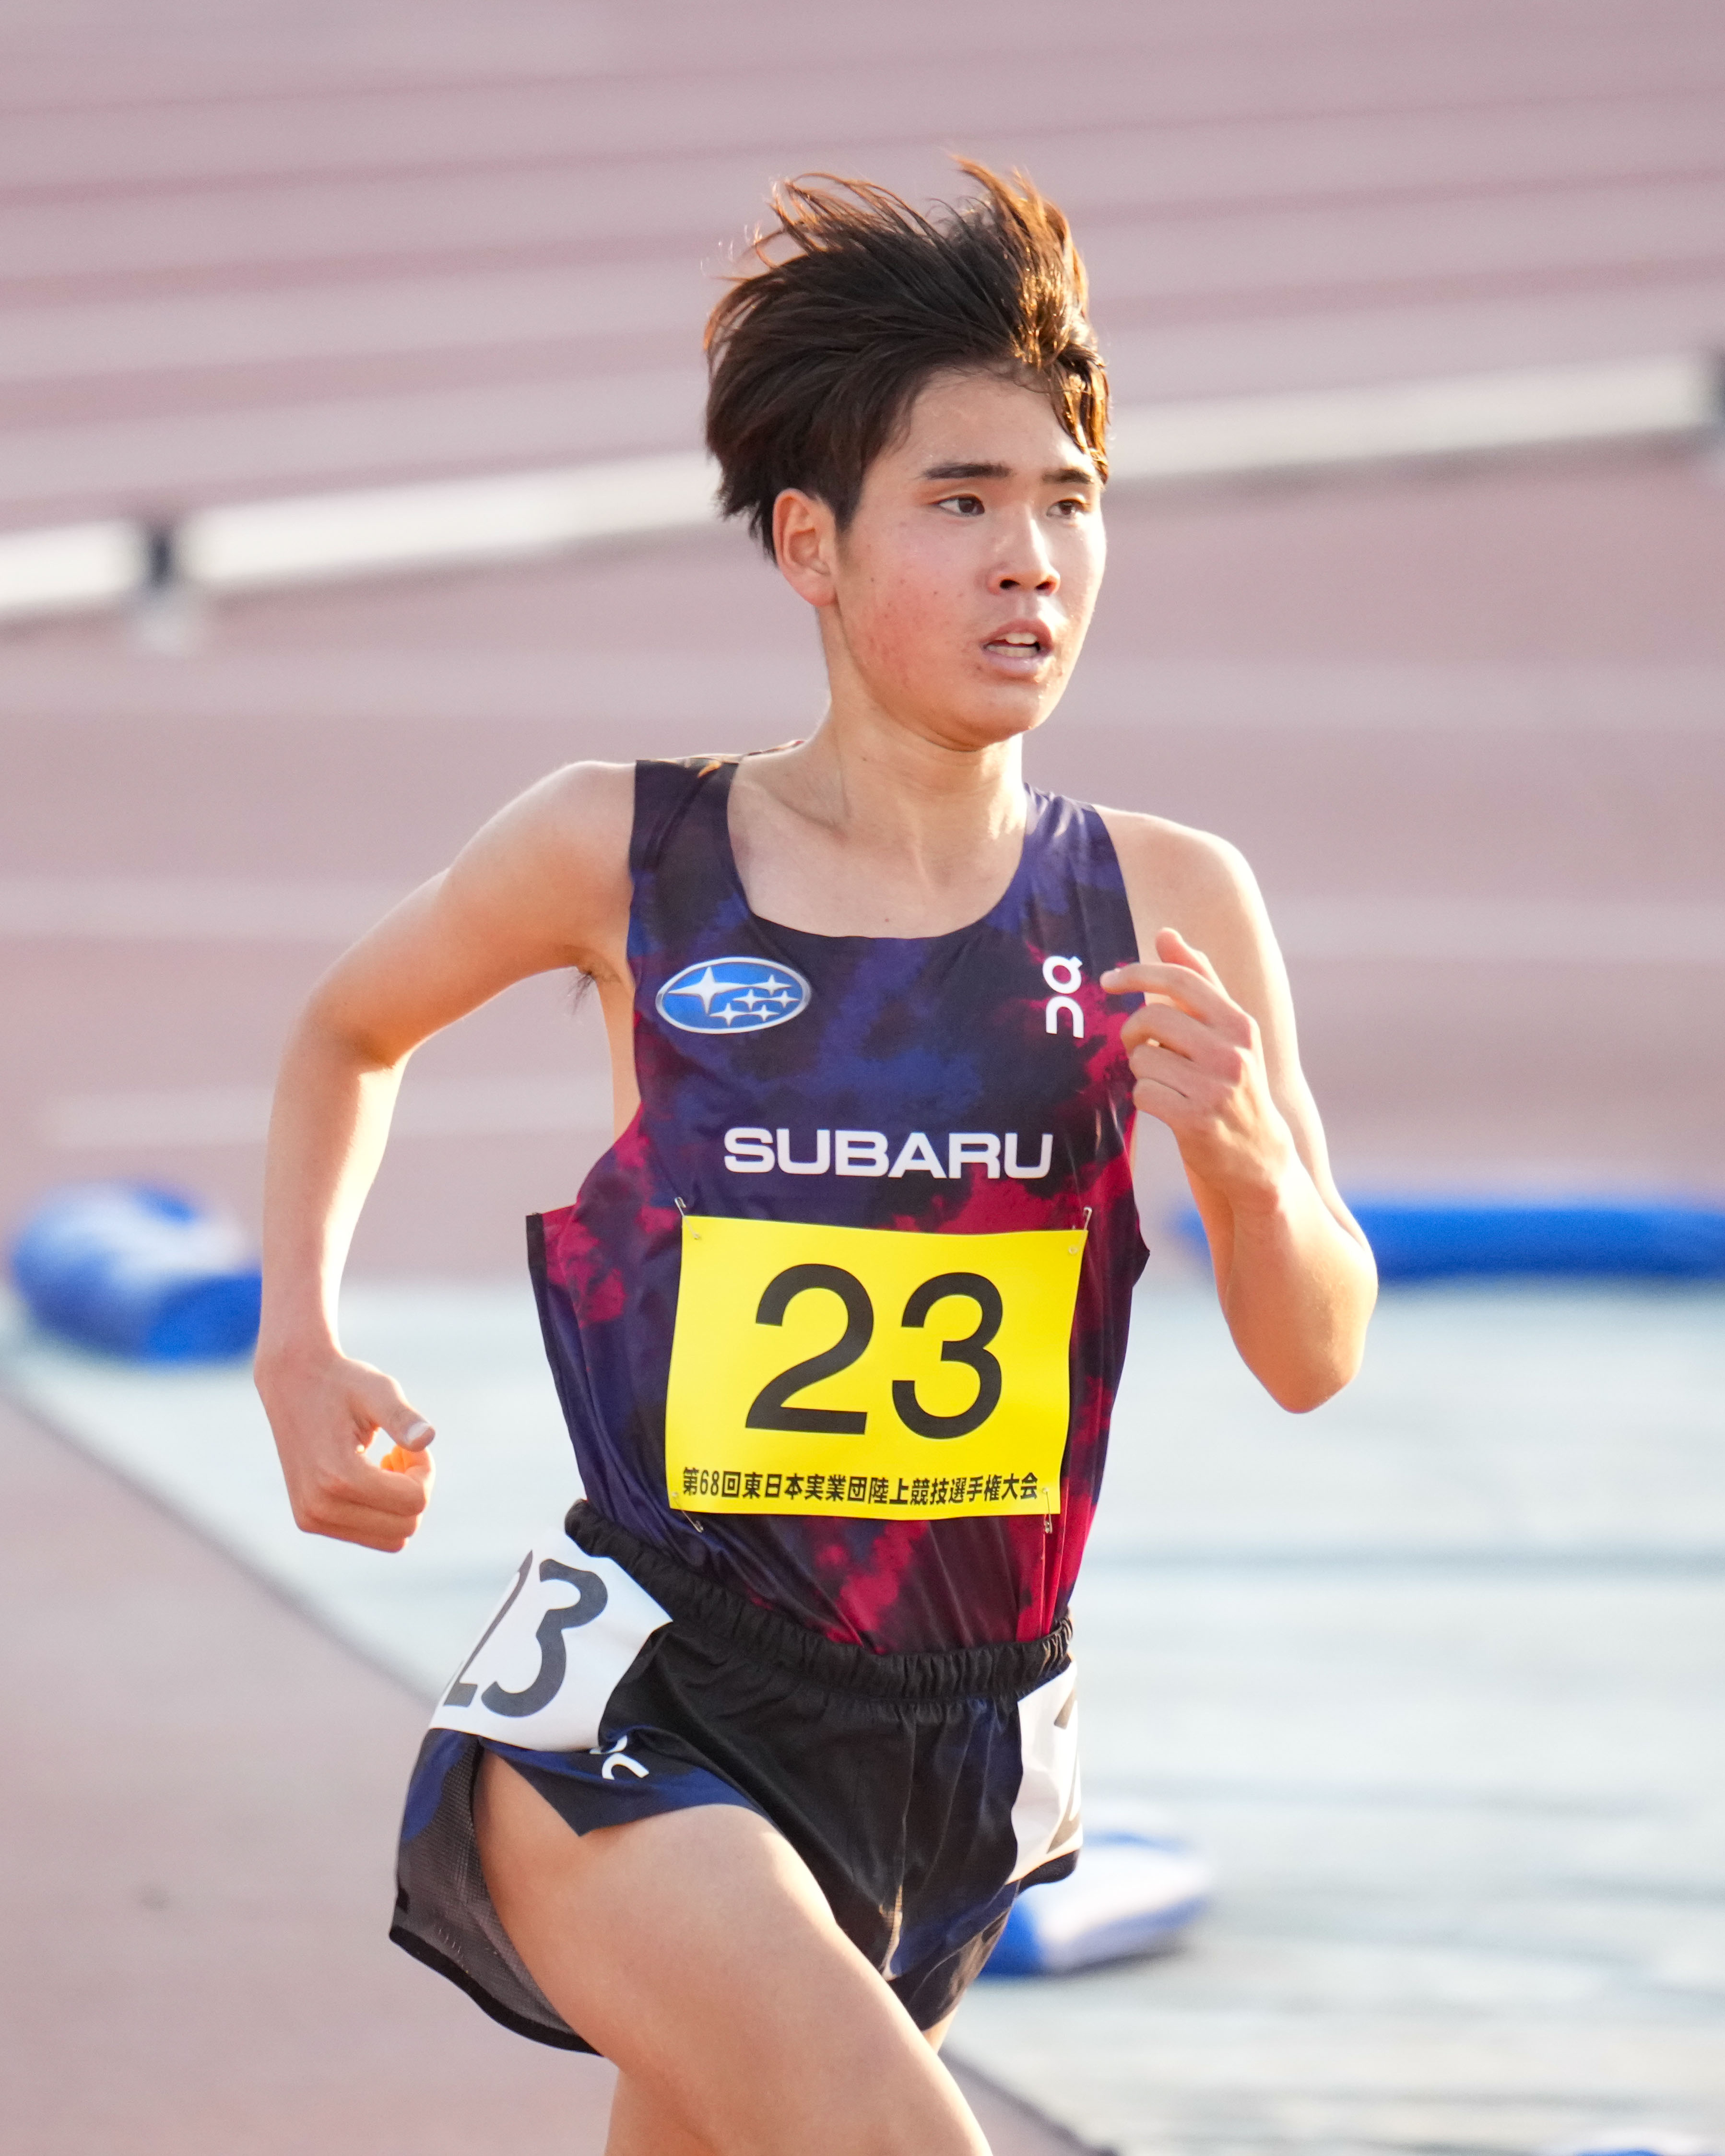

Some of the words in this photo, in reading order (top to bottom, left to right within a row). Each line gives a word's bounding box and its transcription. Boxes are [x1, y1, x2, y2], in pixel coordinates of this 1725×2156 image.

[723, 1127, 1053, 1179] SUBARU
[745, 1263, 1003, 1439] 23
[683, 1467, 1039, 1506] 第68回東日本実業団陸上競技選手権大会
